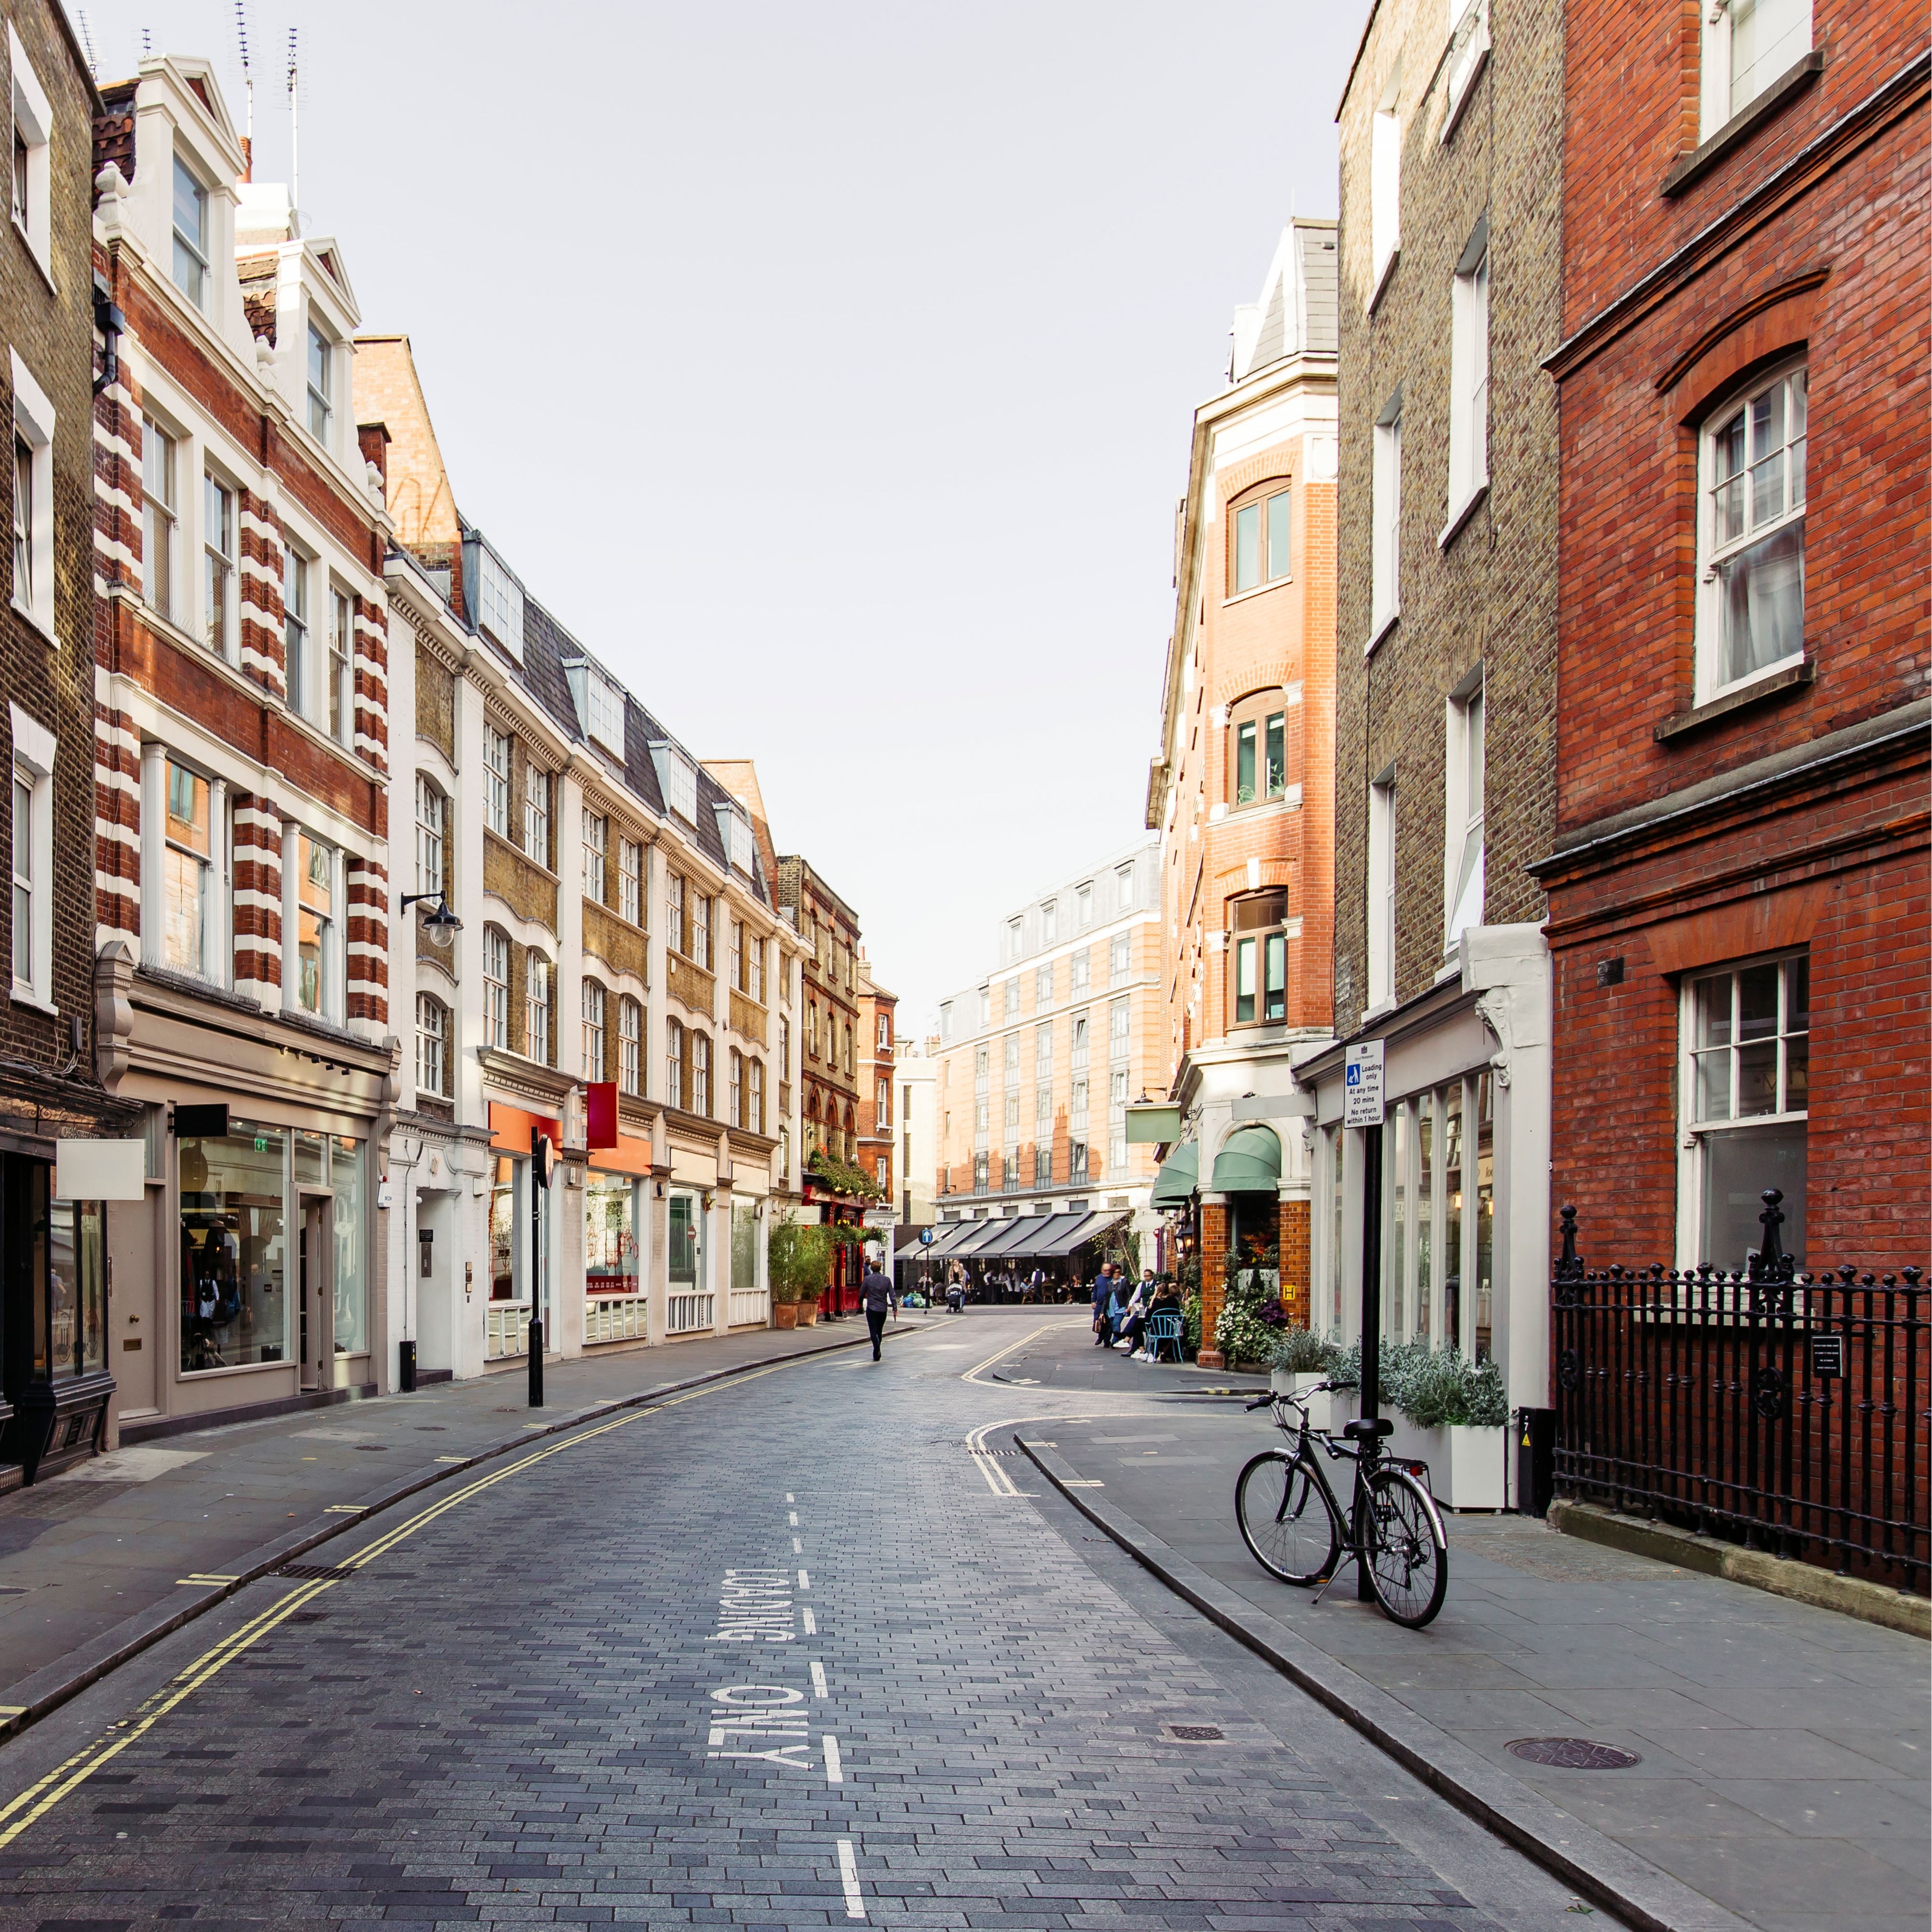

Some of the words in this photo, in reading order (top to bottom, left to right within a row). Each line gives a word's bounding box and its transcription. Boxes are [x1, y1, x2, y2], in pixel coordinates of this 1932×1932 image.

[1362, 1064, 1382, 1072] Loading
[1285, 1287, 1293, 1298] H
[1524, 1422, 1529, 1431] 7
[705, 1569, 796, 1641] LOADING
[708, 1685, 814, 1769] ONLY
